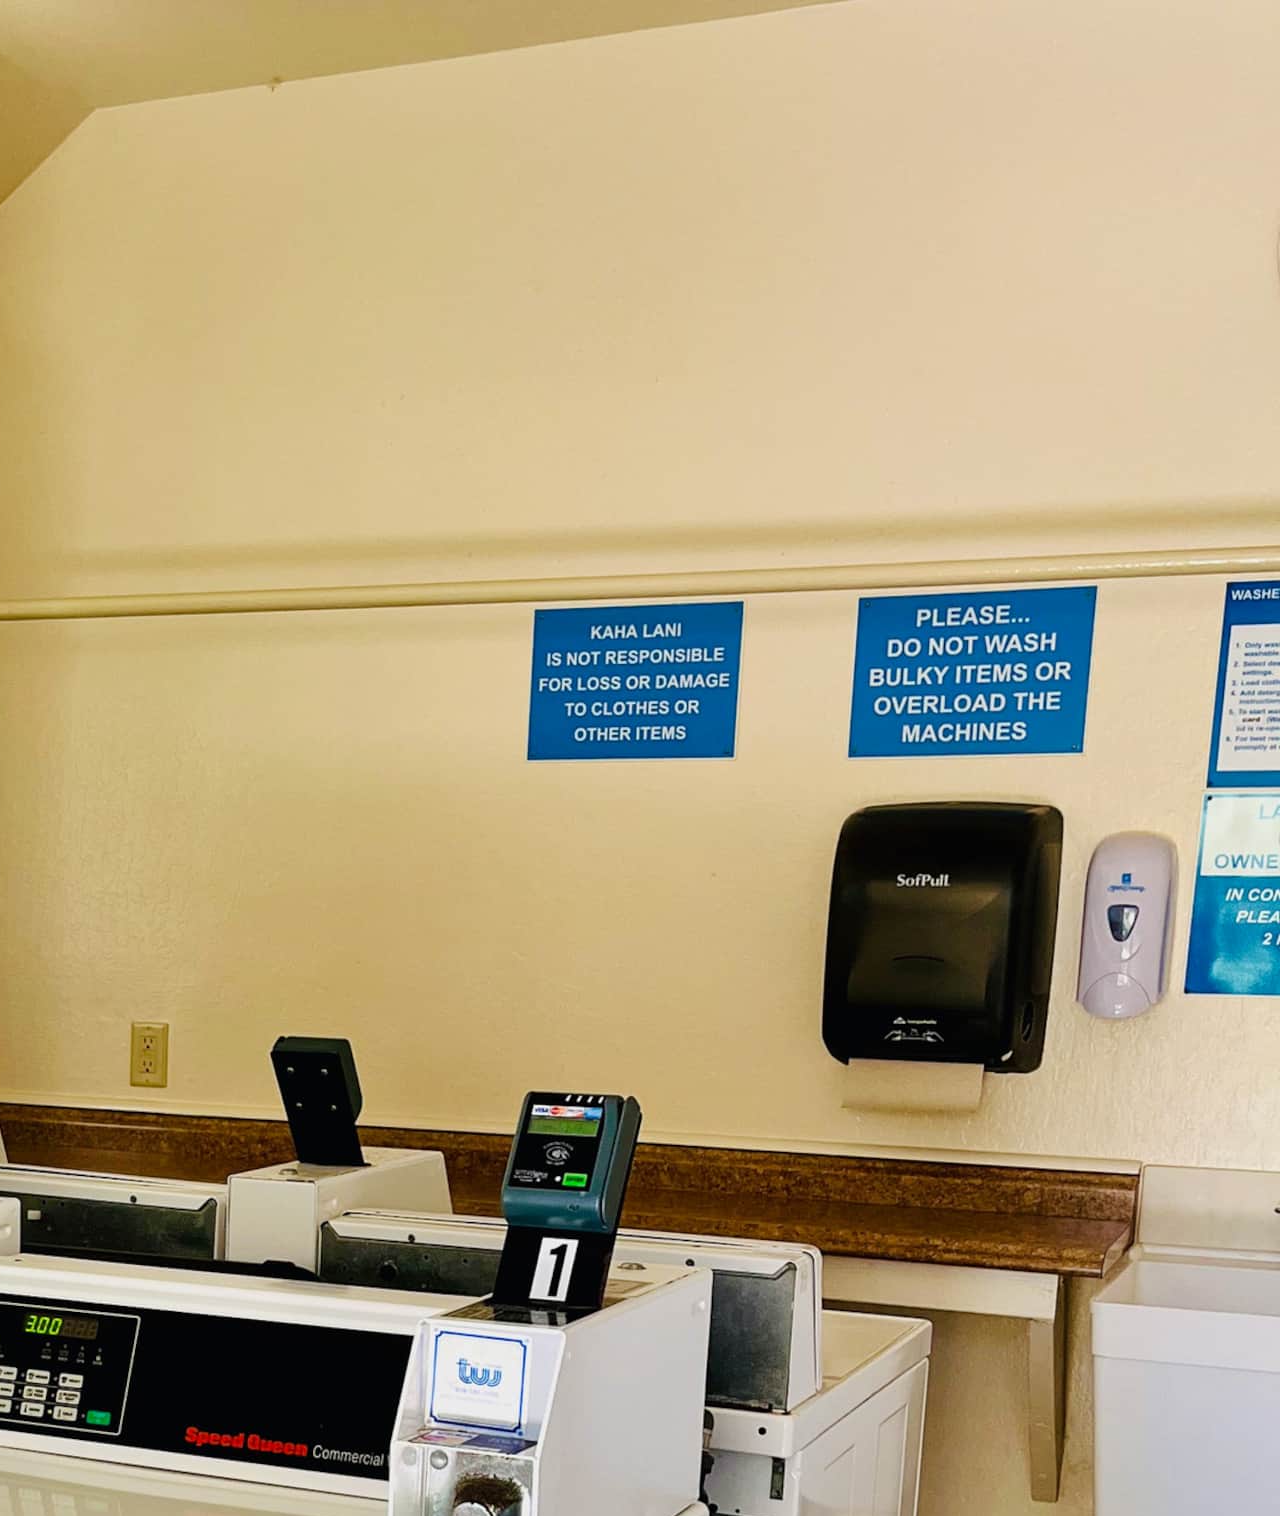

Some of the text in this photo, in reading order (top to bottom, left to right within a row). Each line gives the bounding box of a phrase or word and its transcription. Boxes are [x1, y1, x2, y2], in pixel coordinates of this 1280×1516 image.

[916, 604, 1030, 628] PLEASE...
[590, 622, 682, 640] KAHA LANI
[887, 632, 1057, 658] DO NOT WASH
[546, 647, 725, 667] IS NOT RESPONSIBLE
[538, 673, 730, 692] FOR LOSS OR DAMAGE
[869, 661, 1071, 687] BULKY ITEMS OR
[564, 699, 700, 717] TO CLOTHES OR
[874, 691, 1061, 716] OVERLOAD THE
[574, 725, 687, 742] OTHER ITEMS
[901, 721, 1028, 743] MACHINES
[1214, 853, 1279, 869] OWNE
[895, 873, 952, 888] SofPull
[1225, 887, 1245, 901] IN
[1235, 910, 1280, 924] PLEA
[1262, 932, 1273, 946] 2
[549, 1243, 569, 1298] 1
[184, 1426, 245, 1448] Speed
[247, 1433, 309, 1457] Queen
[312, 1443, 385, 1467] Commercial
